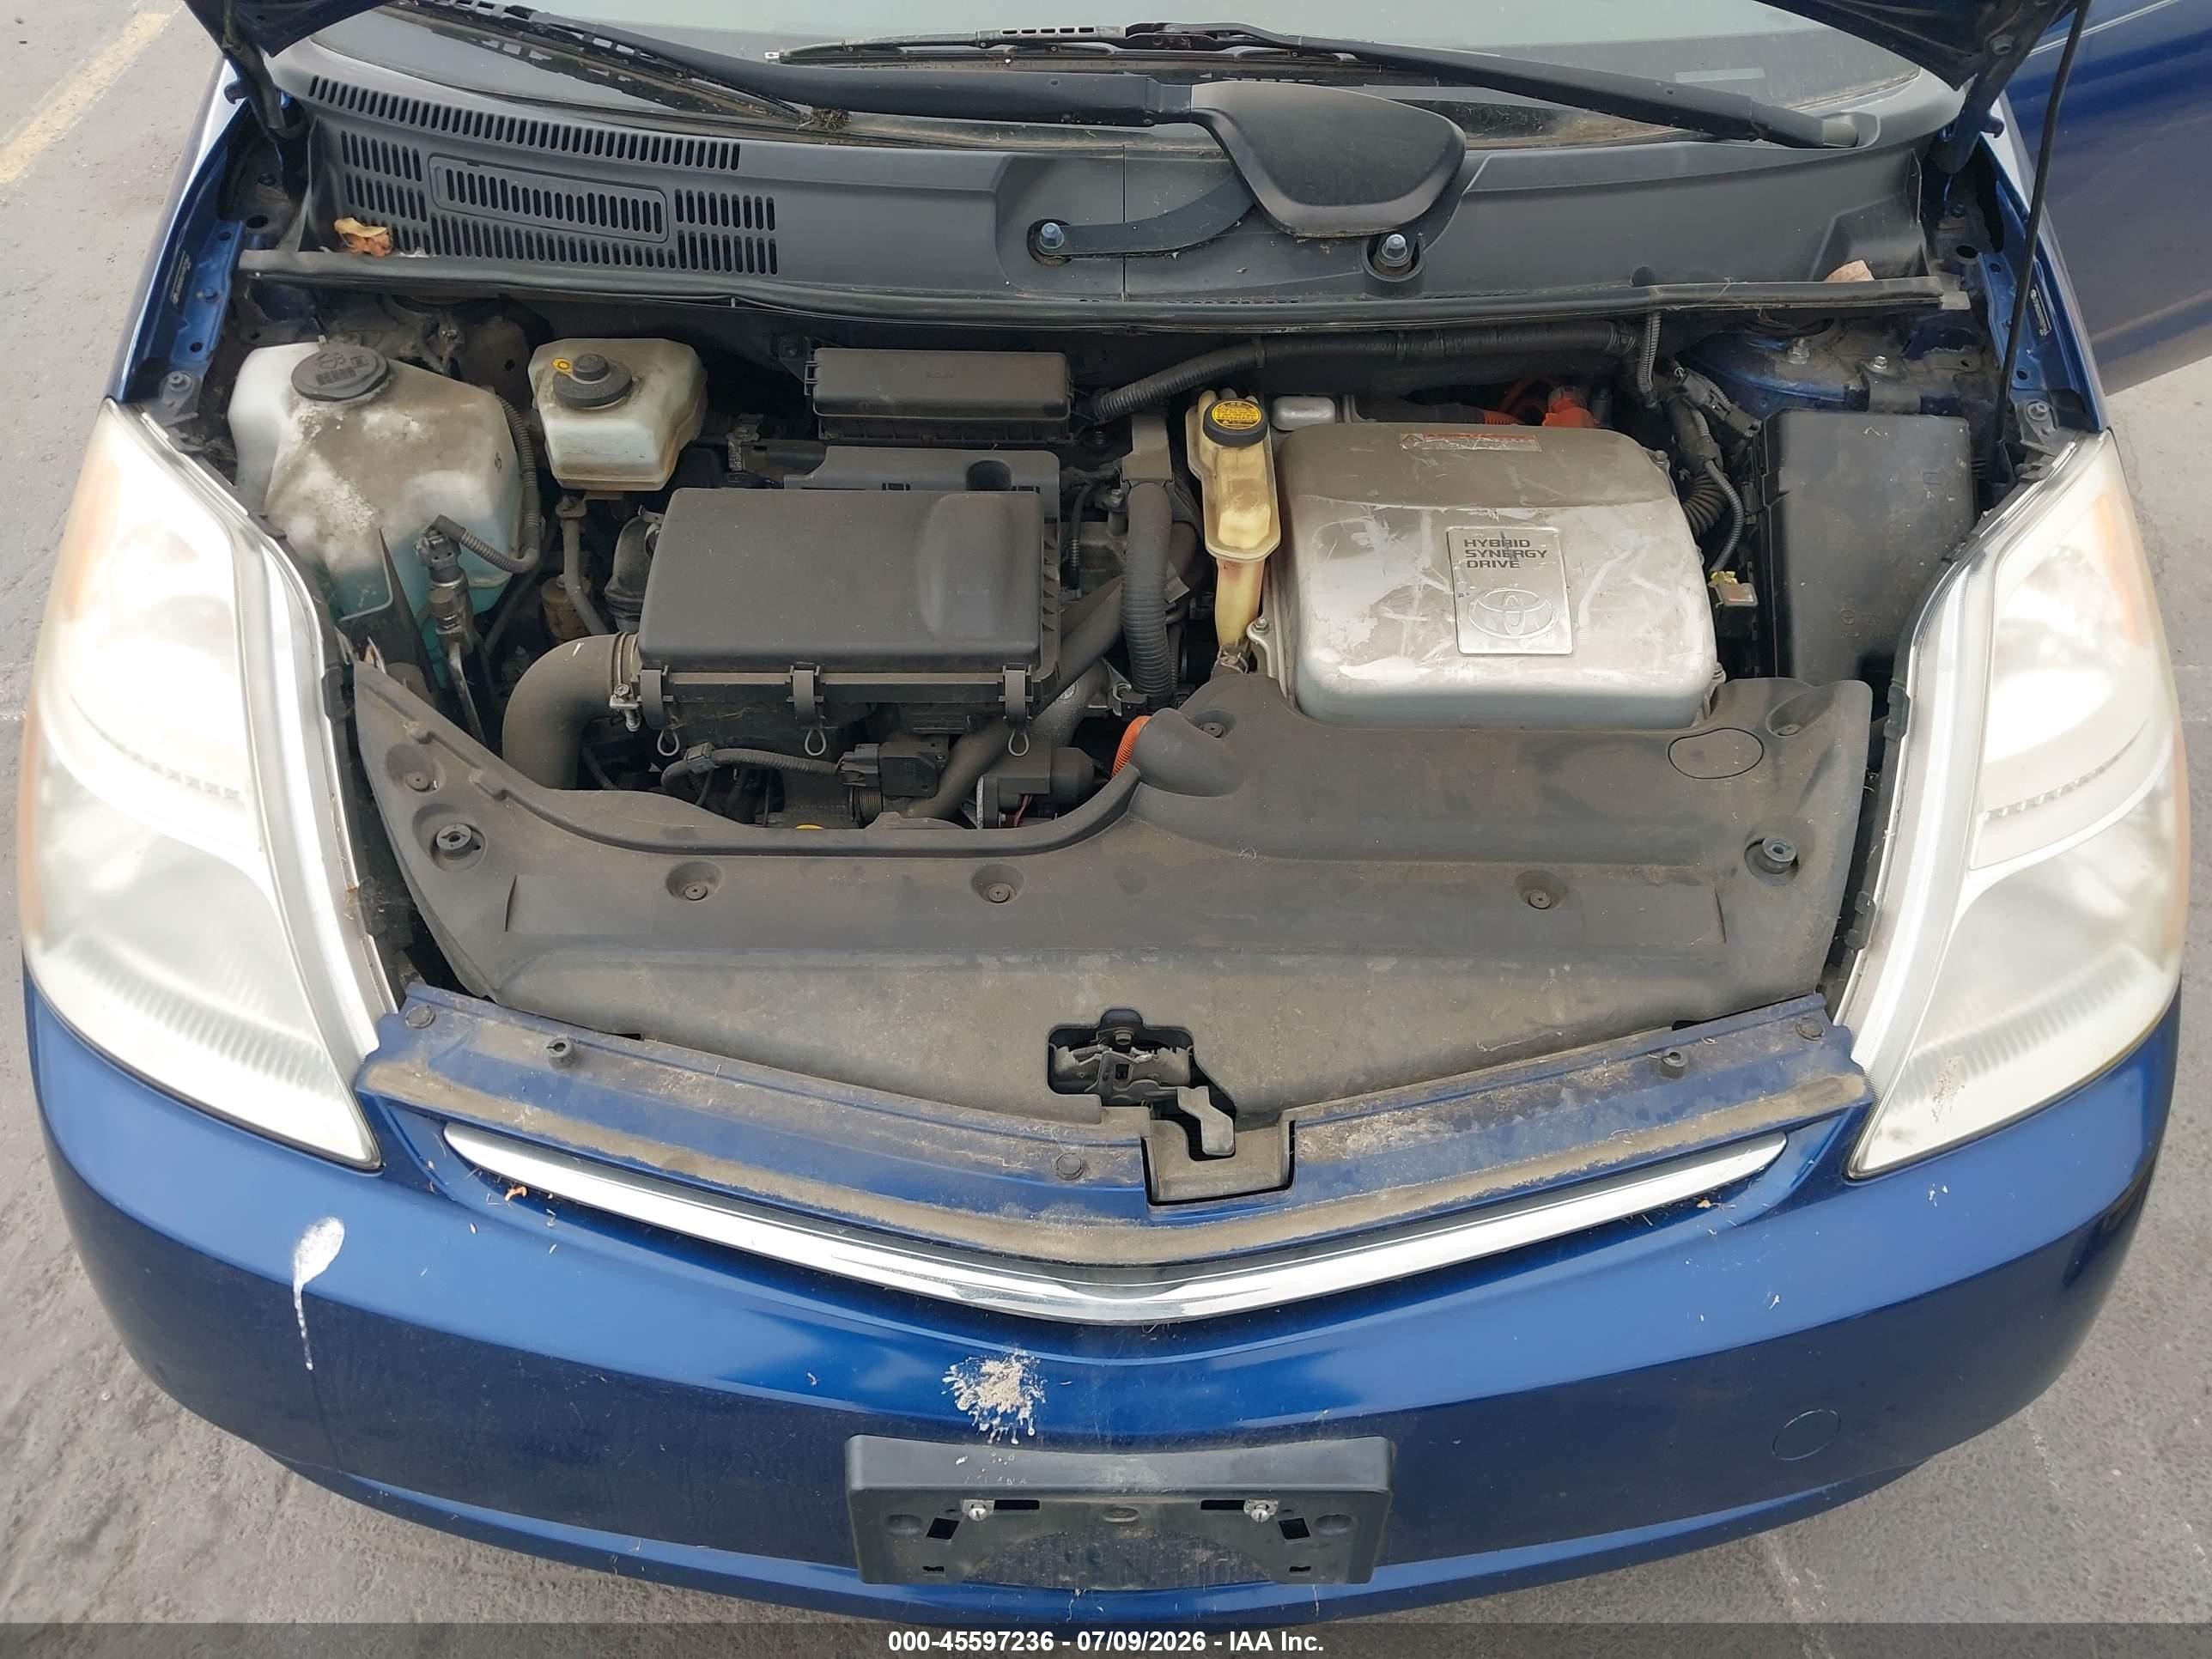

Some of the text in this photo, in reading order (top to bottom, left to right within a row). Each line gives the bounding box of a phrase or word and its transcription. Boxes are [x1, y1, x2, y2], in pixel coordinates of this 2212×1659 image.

[1463, 538, 1531, 548] HYBRID
[1465, 549, 1548, 558] SYNERGY
[1467, 560, 1521, 568] DRIVE
